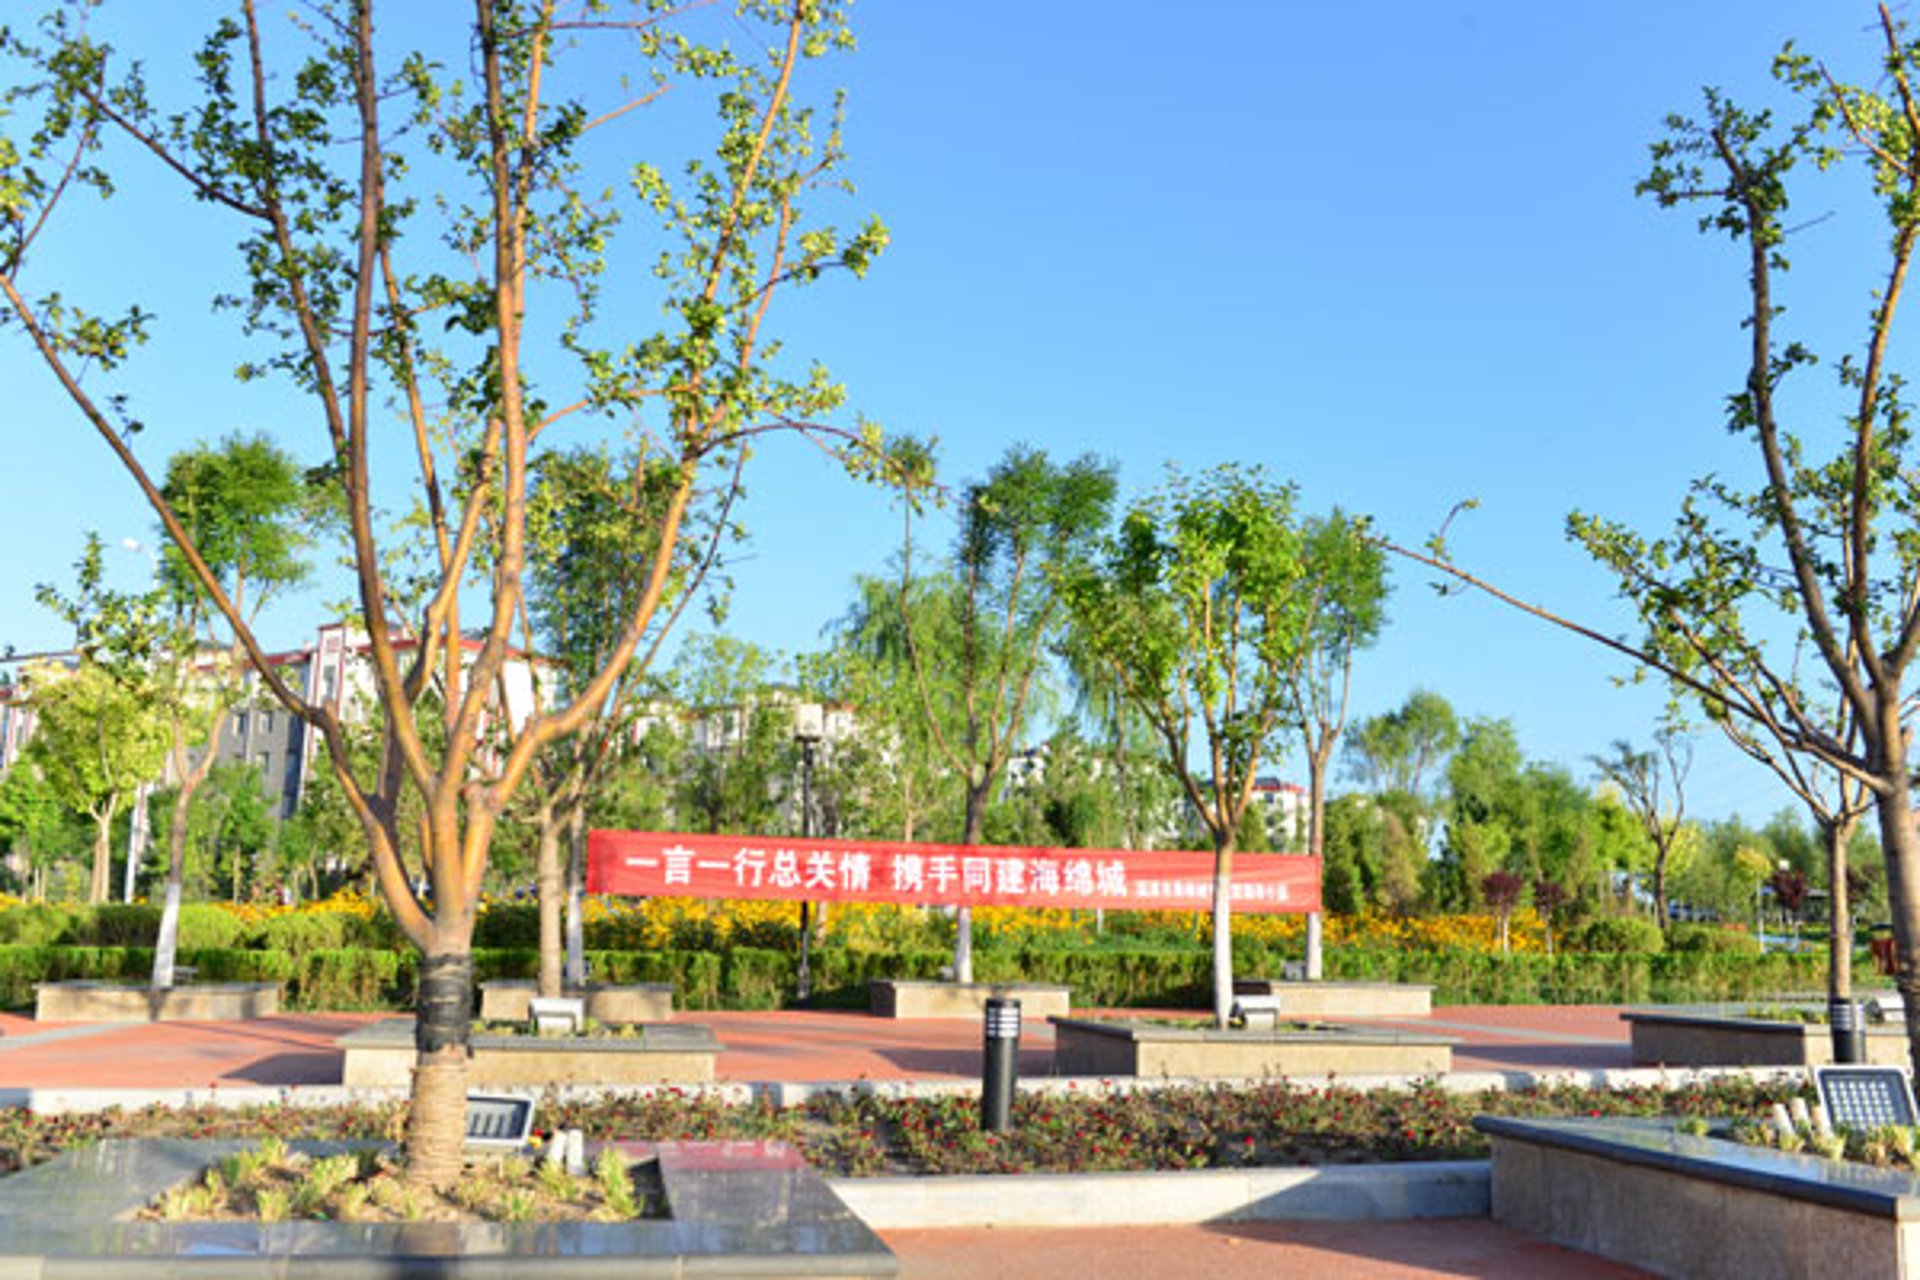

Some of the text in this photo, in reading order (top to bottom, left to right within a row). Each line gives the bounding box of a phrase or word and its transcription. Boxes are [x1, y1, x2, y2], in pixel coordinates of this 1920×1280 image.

[625, 845, 871, 891] 一言一行总关情
[893, 854, 1127, 896] 携手同建海绵城
